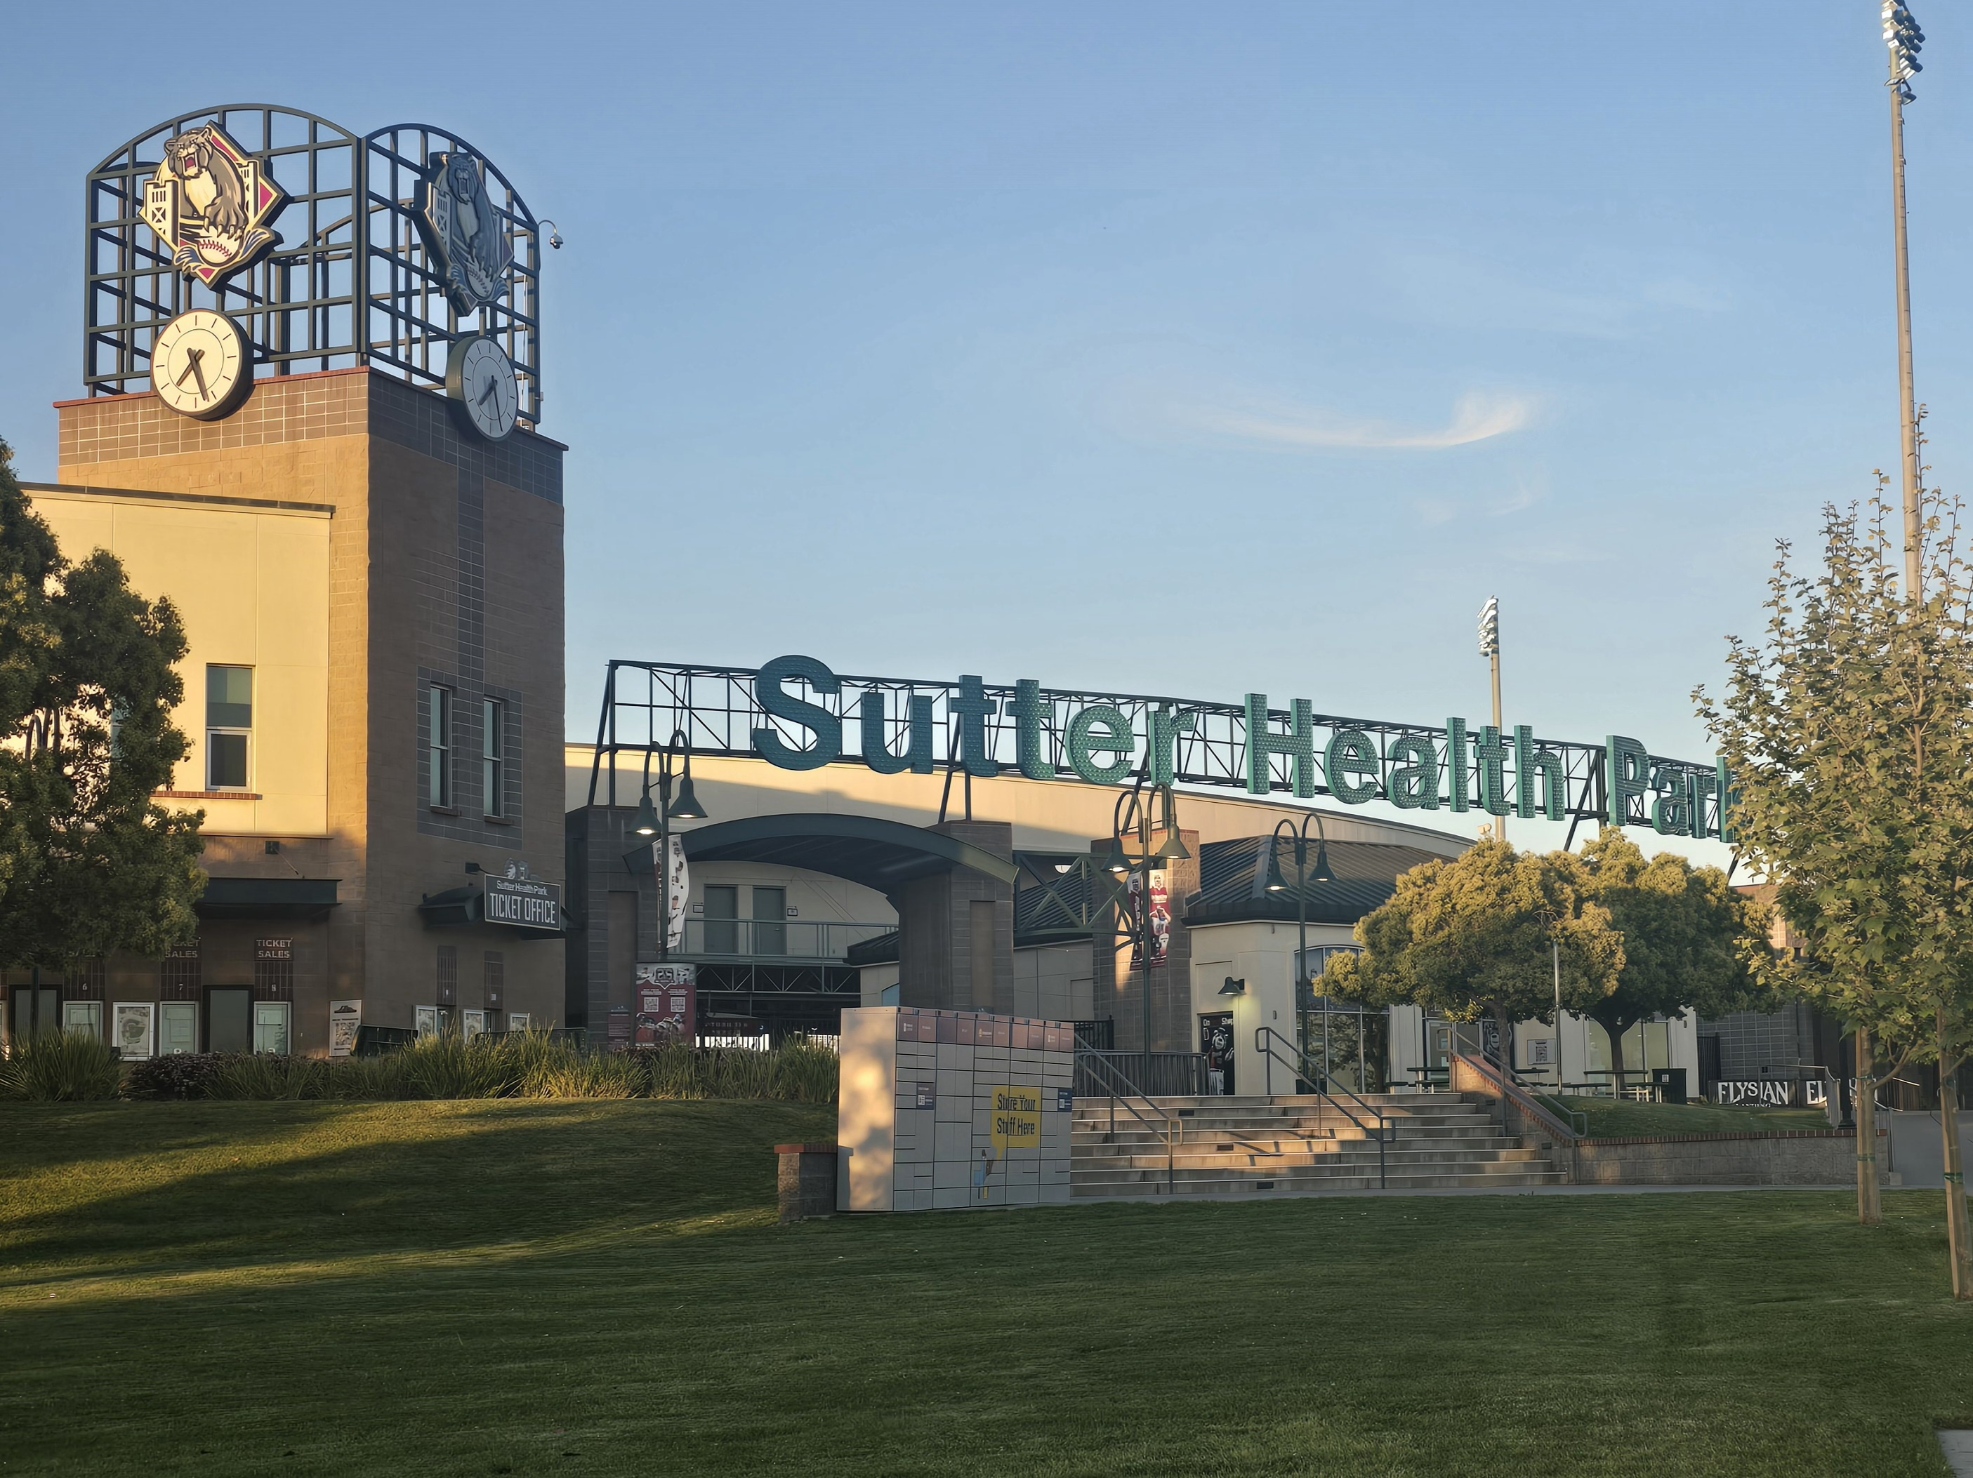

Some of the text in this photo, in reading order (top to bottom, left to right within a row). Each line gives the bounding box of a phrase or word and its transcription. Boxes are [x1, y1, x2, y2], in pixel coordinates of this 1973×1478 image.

[753, 654, 1194, 787] Sutter
[1244, 693, 1566, 821] Health
[496, 880, 548, 896] Sutter Health Park
[489, 893, 556, 924] TICKET OFFICE
[256, 939, 292, 948] TICKET
[165, 950, 198, 959] SALES
[258, 950, 291, 959] SALES
[82, 983, 88, 991] 6
[1717, 1081, 1789, 1105] ELYSIAN
[997, 1093, 1036, 1111] Store Your
[996, 1117, 1035, 1135] Stuff Here
